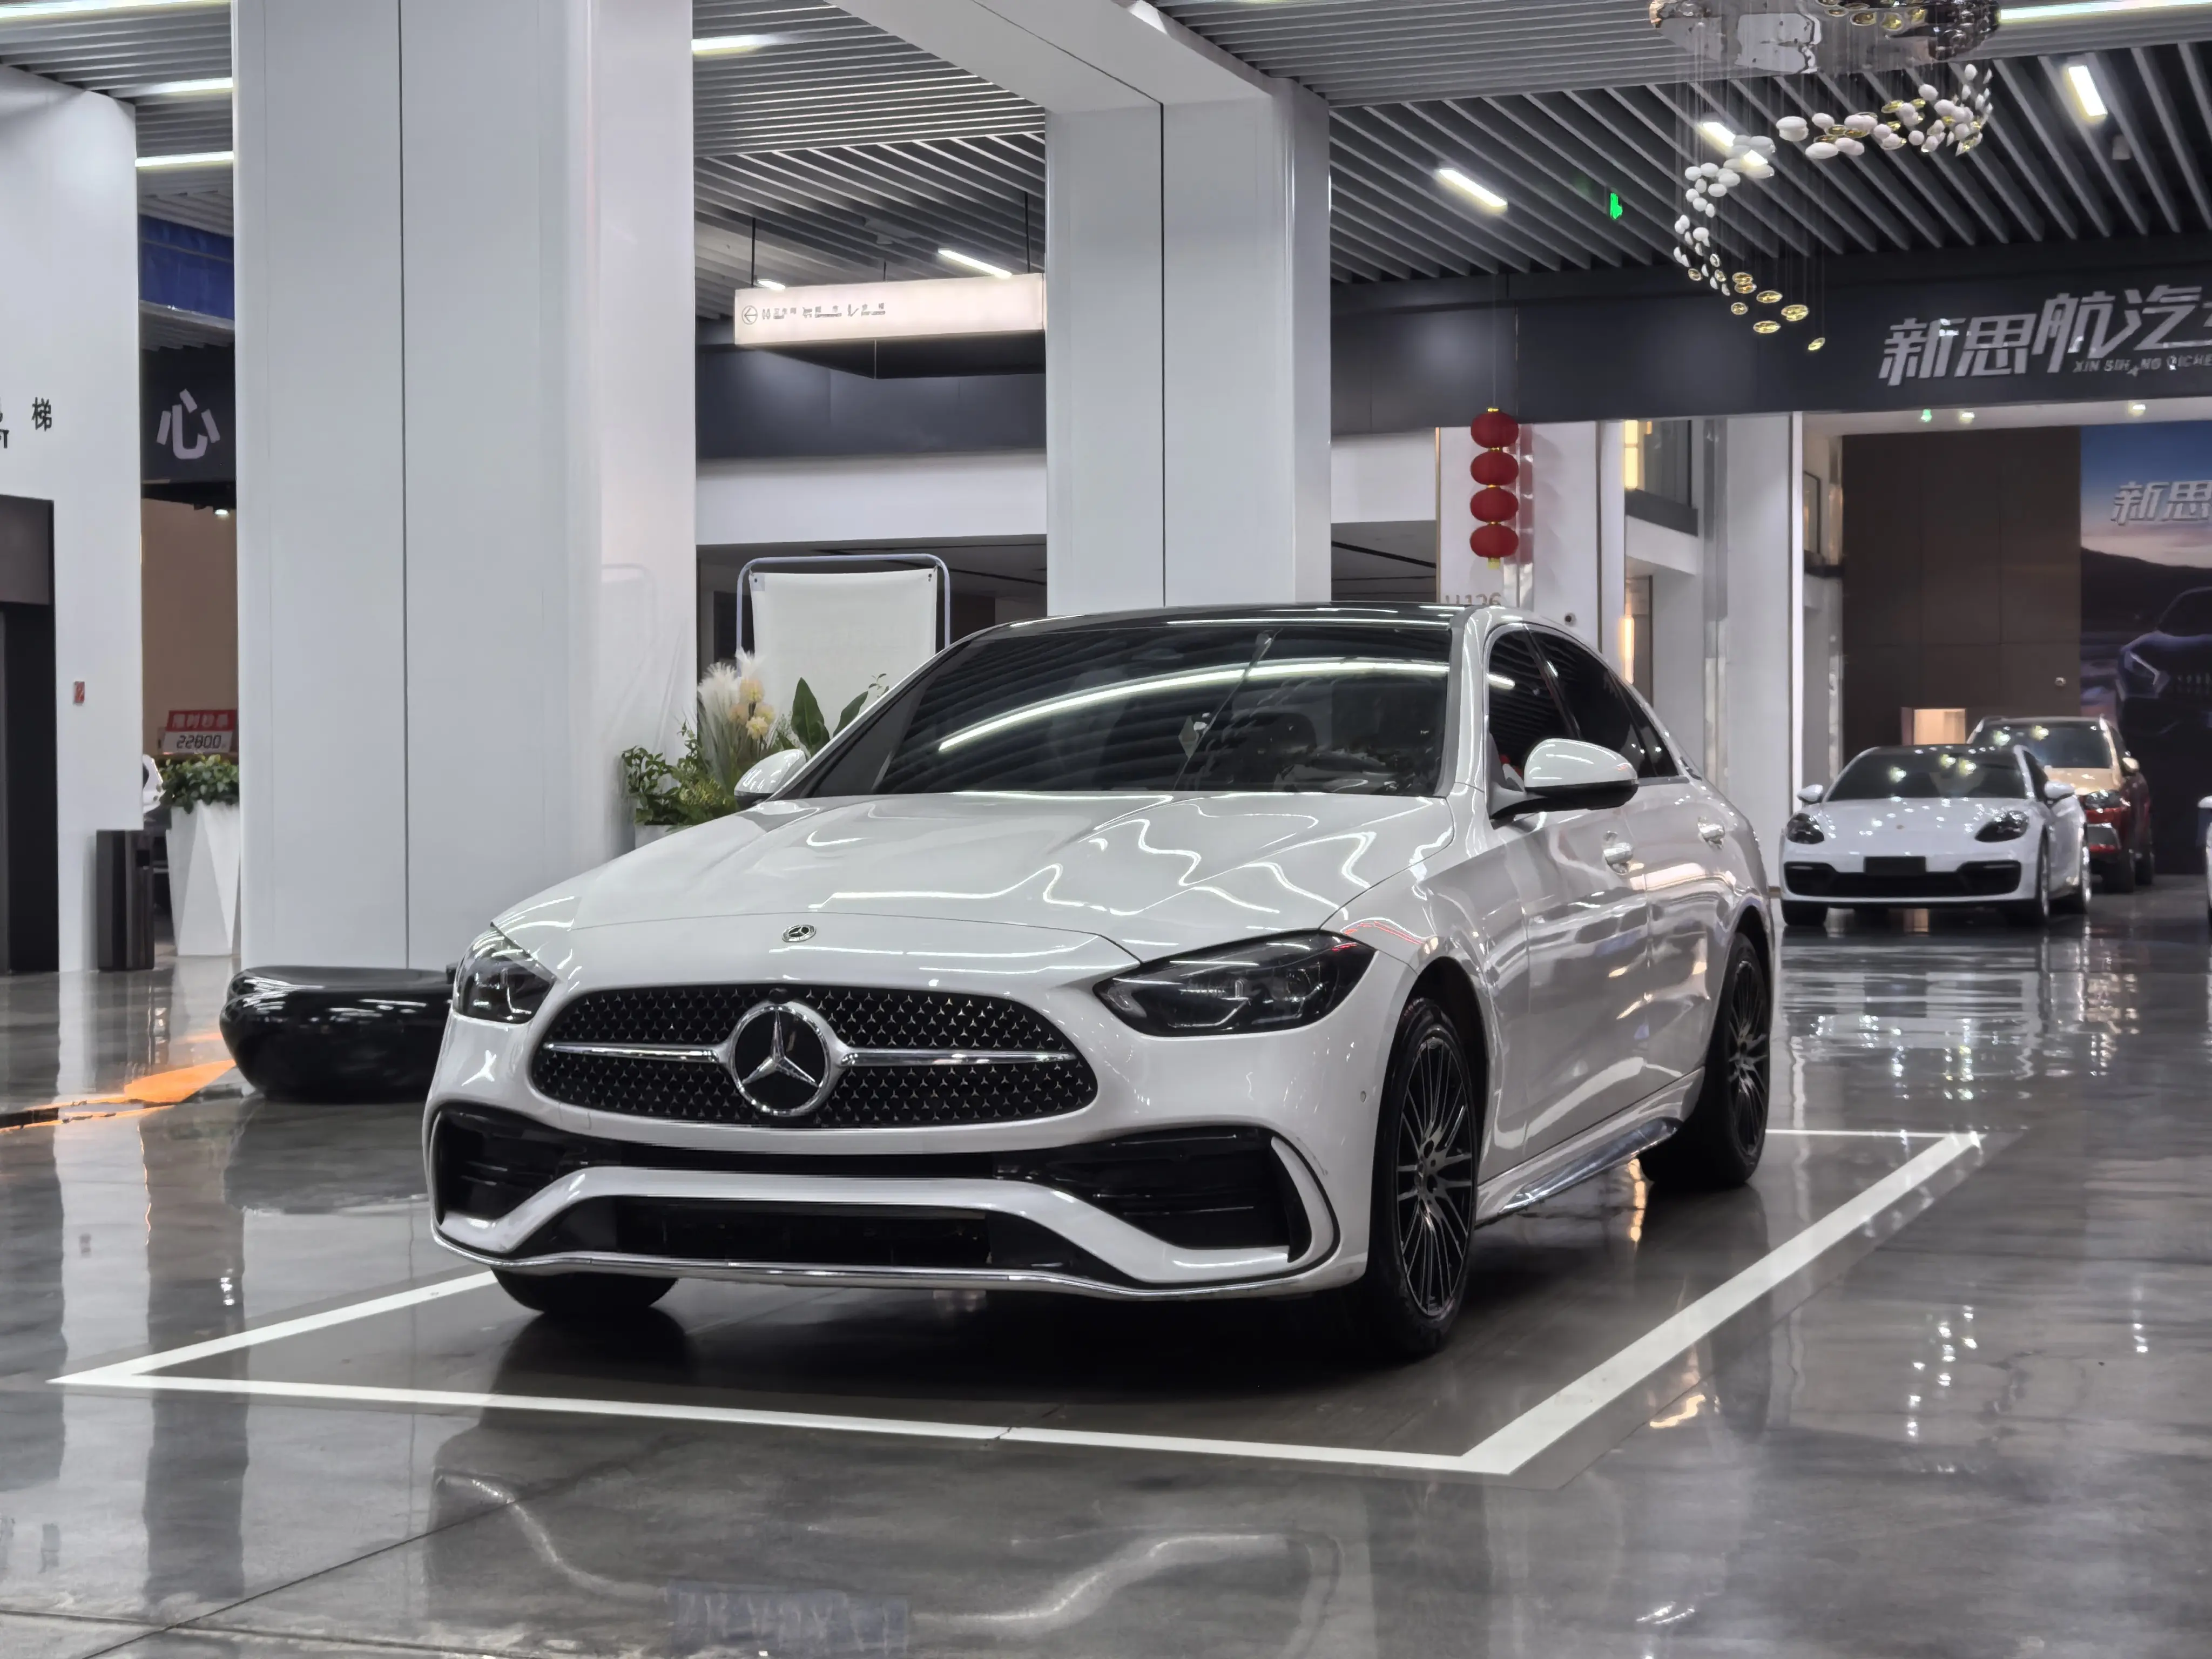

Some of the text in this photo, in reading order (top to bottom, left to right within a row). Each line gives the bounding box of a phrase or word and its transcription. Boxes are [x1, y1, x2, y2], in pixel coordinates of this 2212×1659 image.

[1878, 285, 2212, 387] 新思航汽
[2073, 360, 2101, 373] XIN
[0, 428, 10, 449] T
[157, 388, 220, 460] 心
